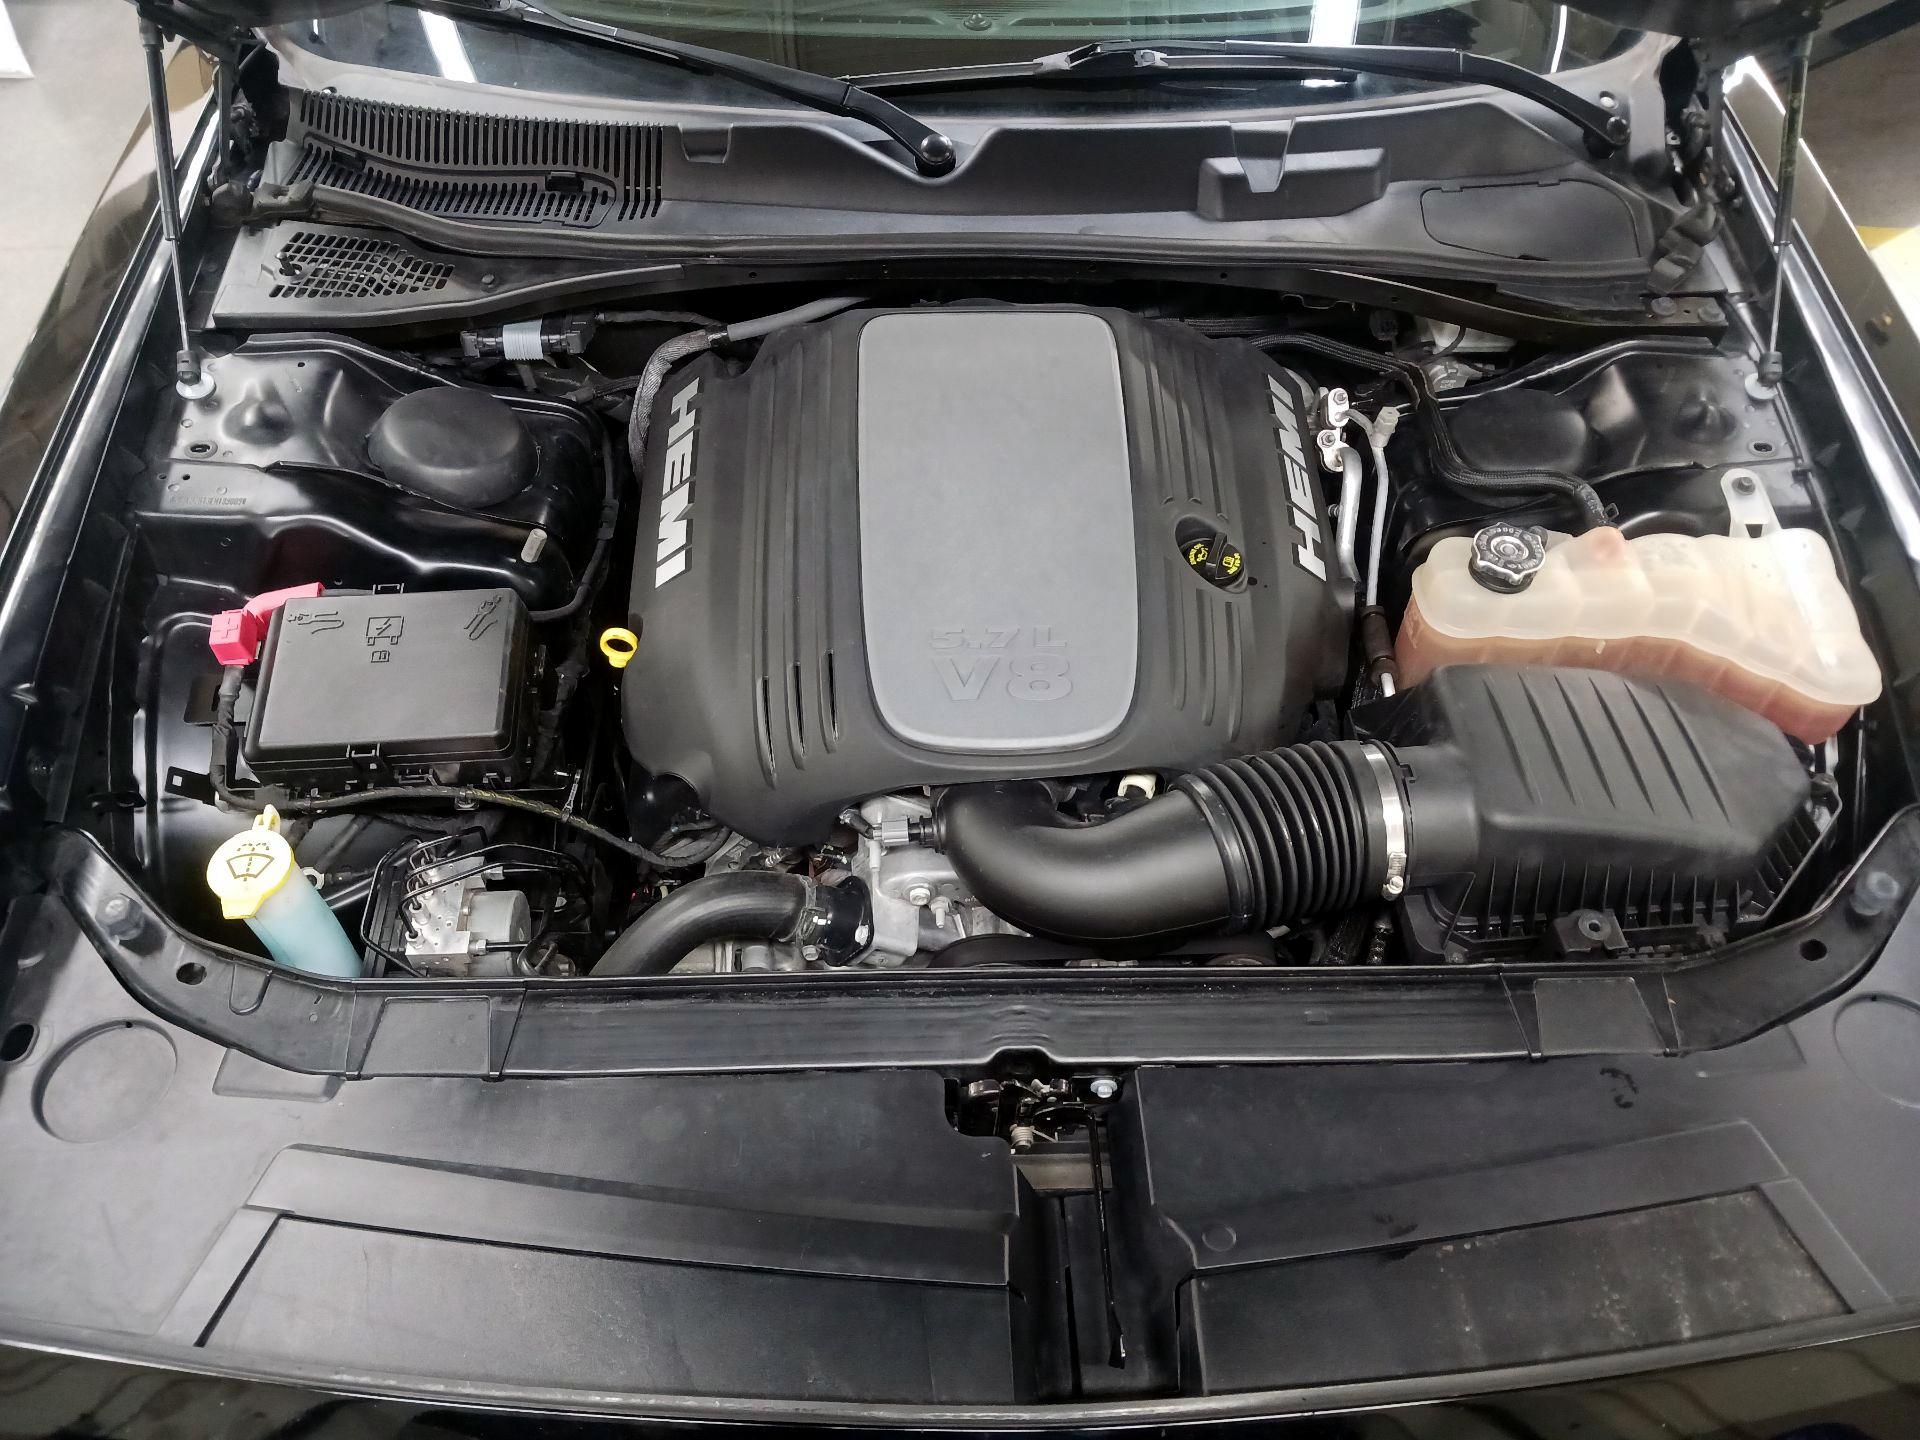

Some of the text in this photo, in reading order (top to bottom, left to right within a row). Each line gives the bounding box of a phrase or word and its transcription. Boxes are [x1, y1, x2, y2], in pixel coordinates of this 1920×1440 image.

[654, 377, 700, 589] HEMI
[1267, 374, 1327, 582] HEMI
[930, 652, 1073, 701] V8
